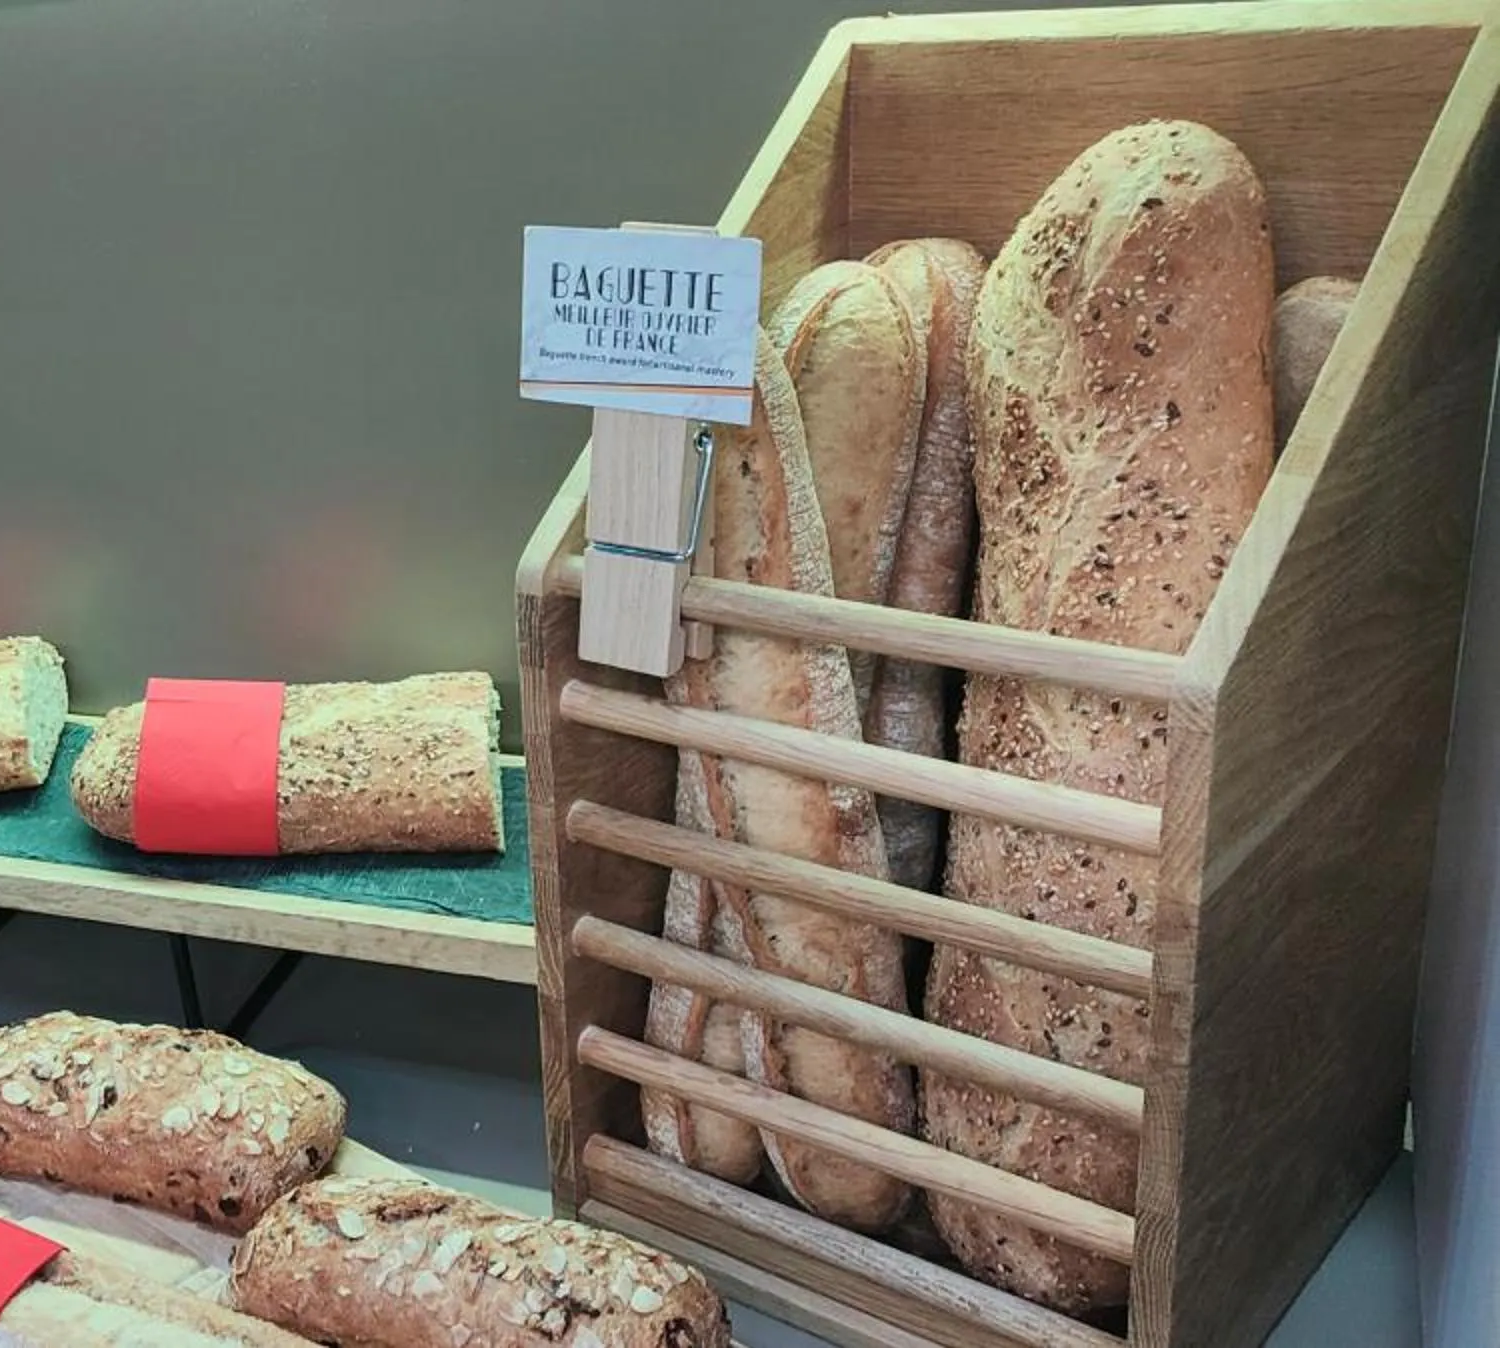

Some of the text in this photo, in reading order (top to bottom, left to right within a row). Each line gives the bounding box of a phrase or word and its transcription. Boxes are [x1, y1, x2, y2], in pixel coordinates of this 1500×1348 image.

[550, 261, 726, 313] BAGUETTE
[554, 303, 717, 336] MEILLEUR OUVRIER
[539, 346, 577, 360] Baguette
[586, 326, 677, 355] DE FRANCE
